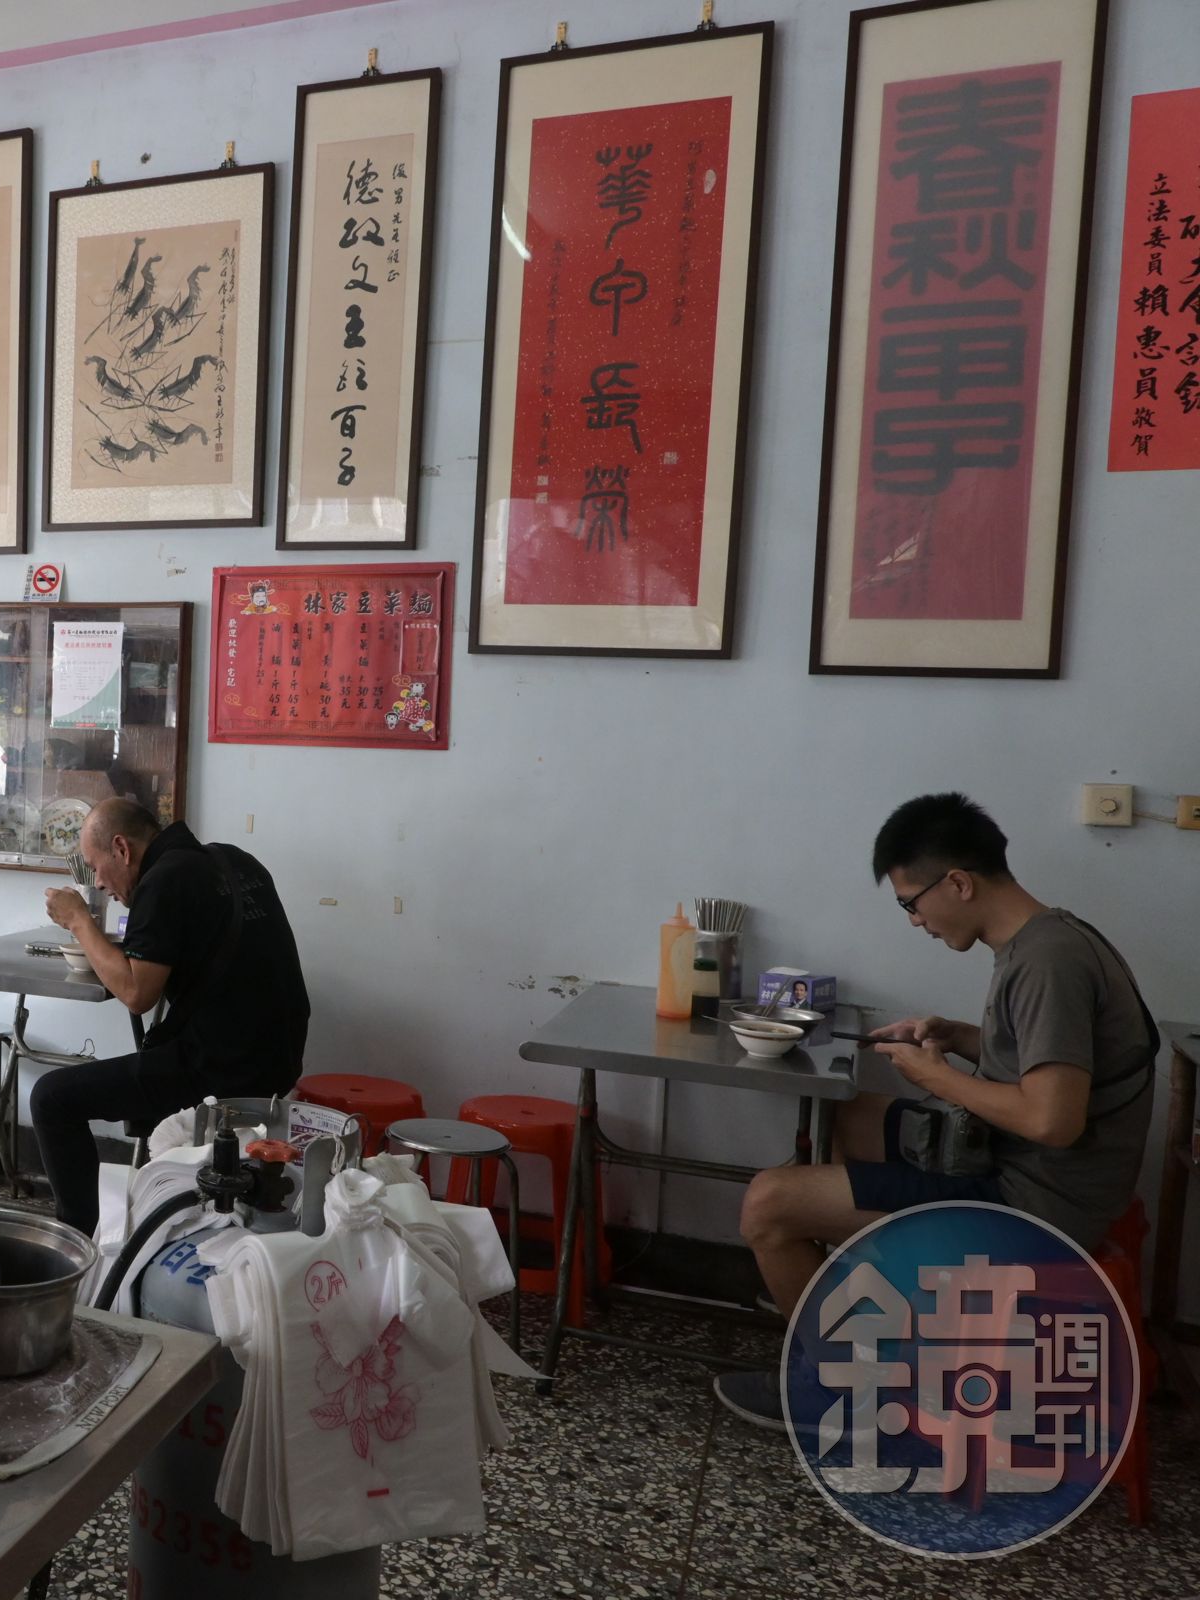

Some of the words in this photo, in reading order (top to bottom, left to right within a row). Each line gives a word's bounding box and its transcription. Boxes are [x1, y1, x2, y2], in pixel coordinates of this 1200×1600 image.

[304, 591, 433, 616] 林家豆菜麵
[76, 1406, 105, 1430] NEW
[99, 1384, 129, 1407] PORT
